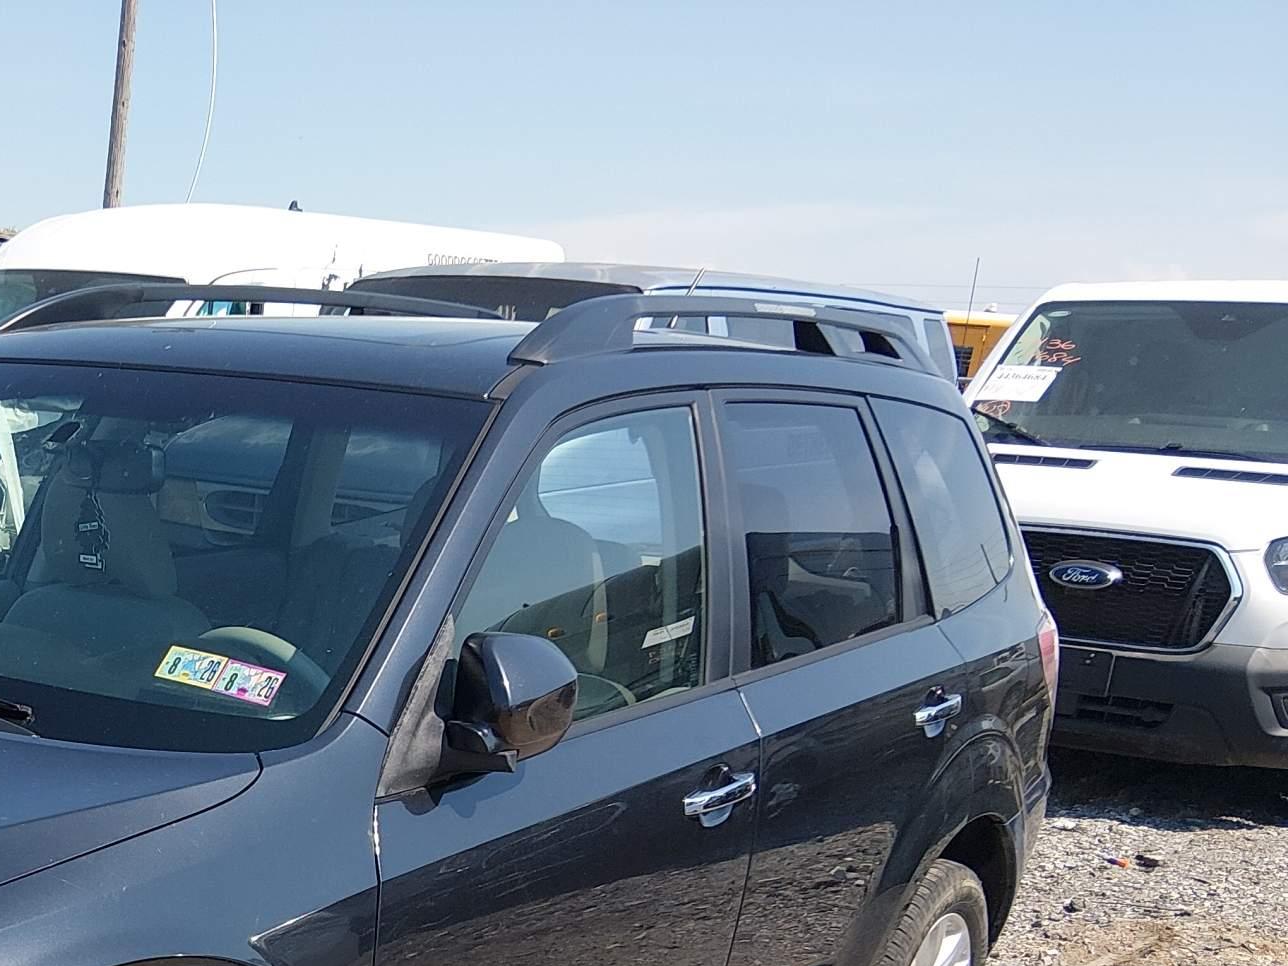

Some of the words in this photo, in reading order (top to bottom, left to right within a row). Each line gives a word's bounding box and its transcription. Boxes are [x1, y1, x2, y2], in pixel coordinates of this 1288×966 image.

[1062, 567, 1100, 583] Ford
[168, 657, 182, 675] 8
[200, 660, 221, 682] 26
[224, 673, 238, 691] 8
[257, 676, 279, 699] 26
